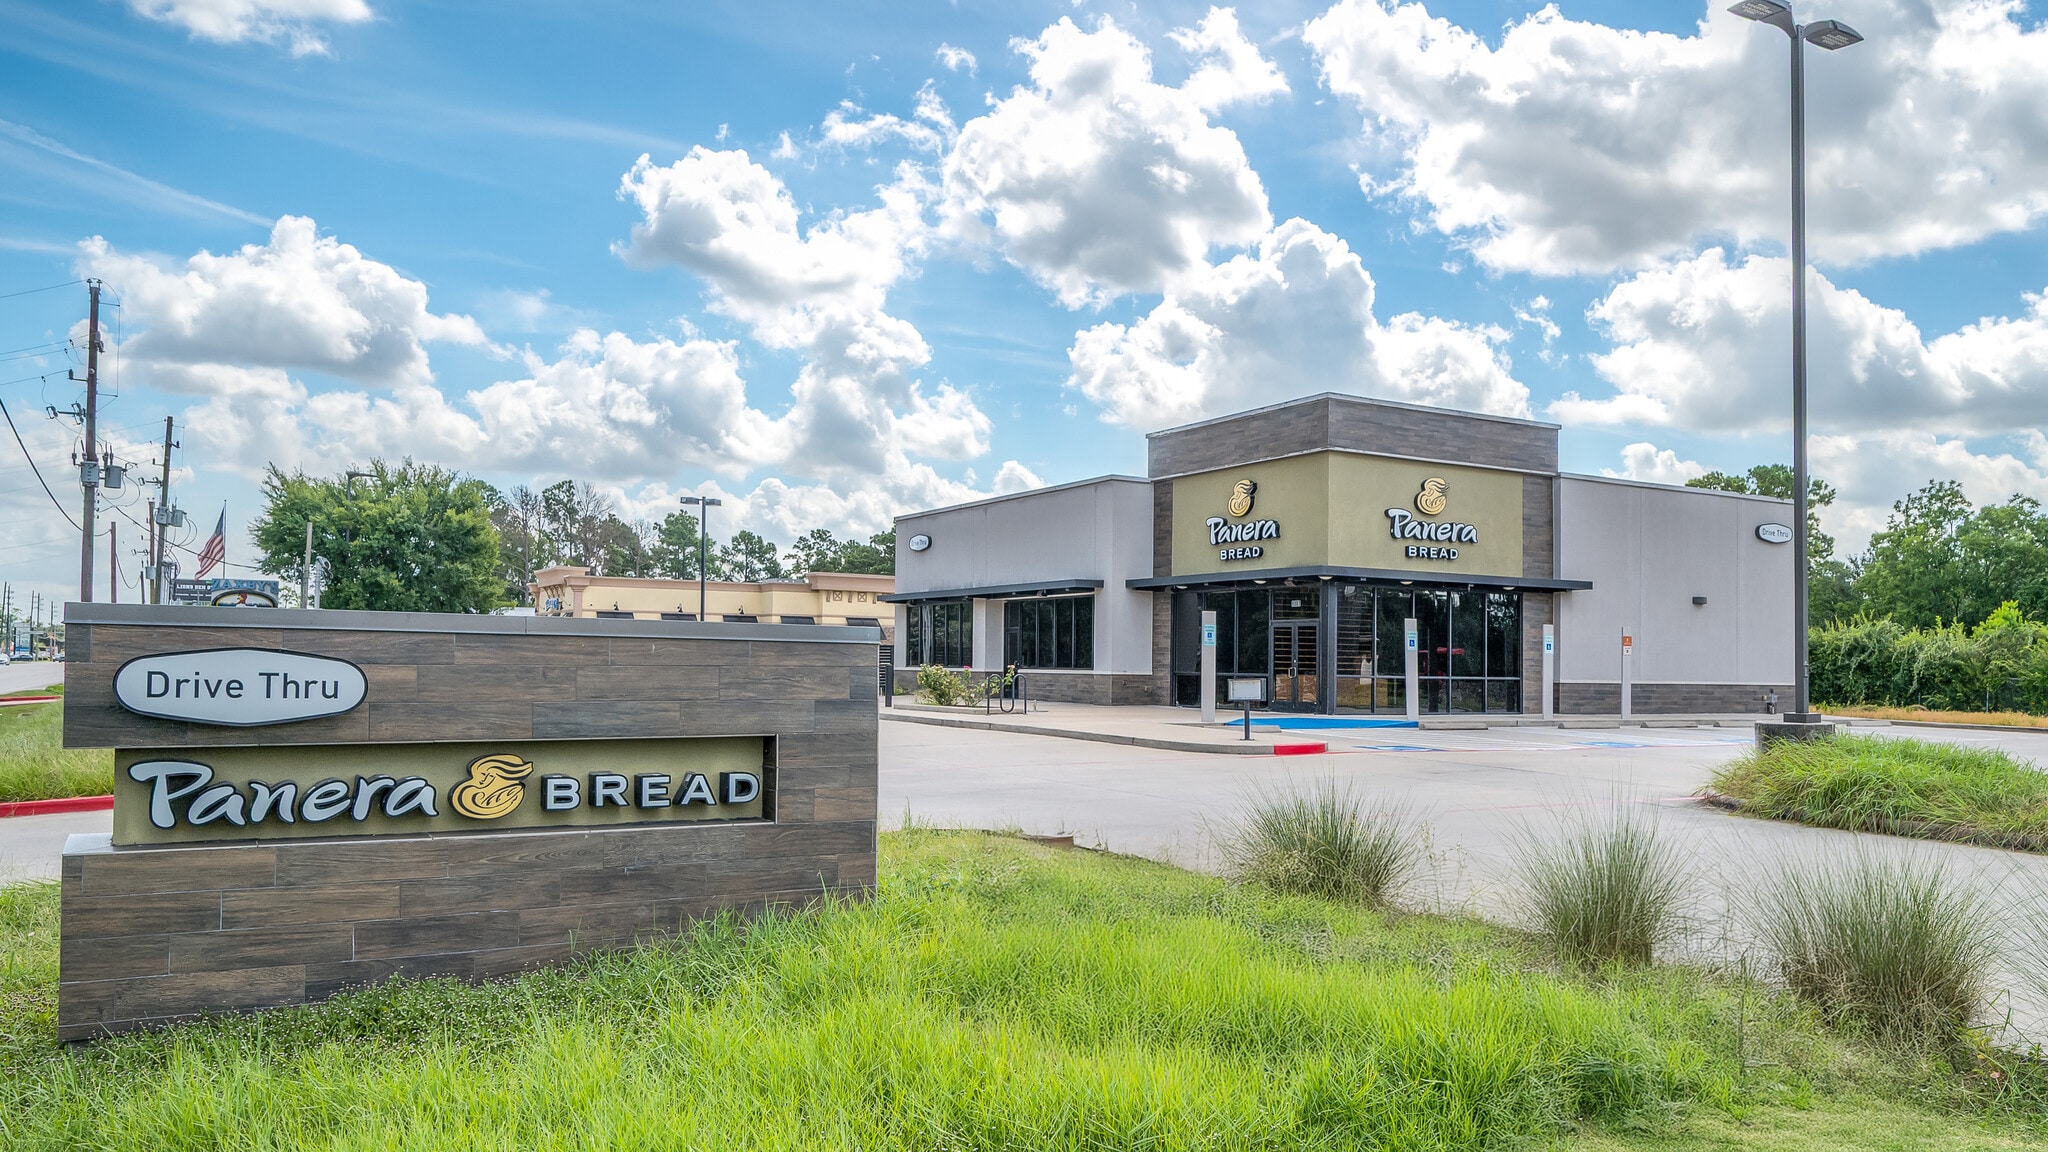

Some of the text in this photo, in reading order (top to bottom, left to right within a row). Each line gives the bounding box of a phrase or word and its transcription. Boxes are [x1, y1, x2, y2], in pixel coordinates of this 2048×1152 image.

[1206, 516, 1280, 545] Panera
[1384, 508, 1478, 543] Panera
[1762, 528, 1775, 536] Drive
[1220, 547, 1263, 561] BREAD
[1405, 545, 1459, 560] BREAD
[211, 578, 279, 594] ZAXBY'S
[146, 670, 339, 699] Drive Thru
[128, 759, 760, 829] Panera BREAD
